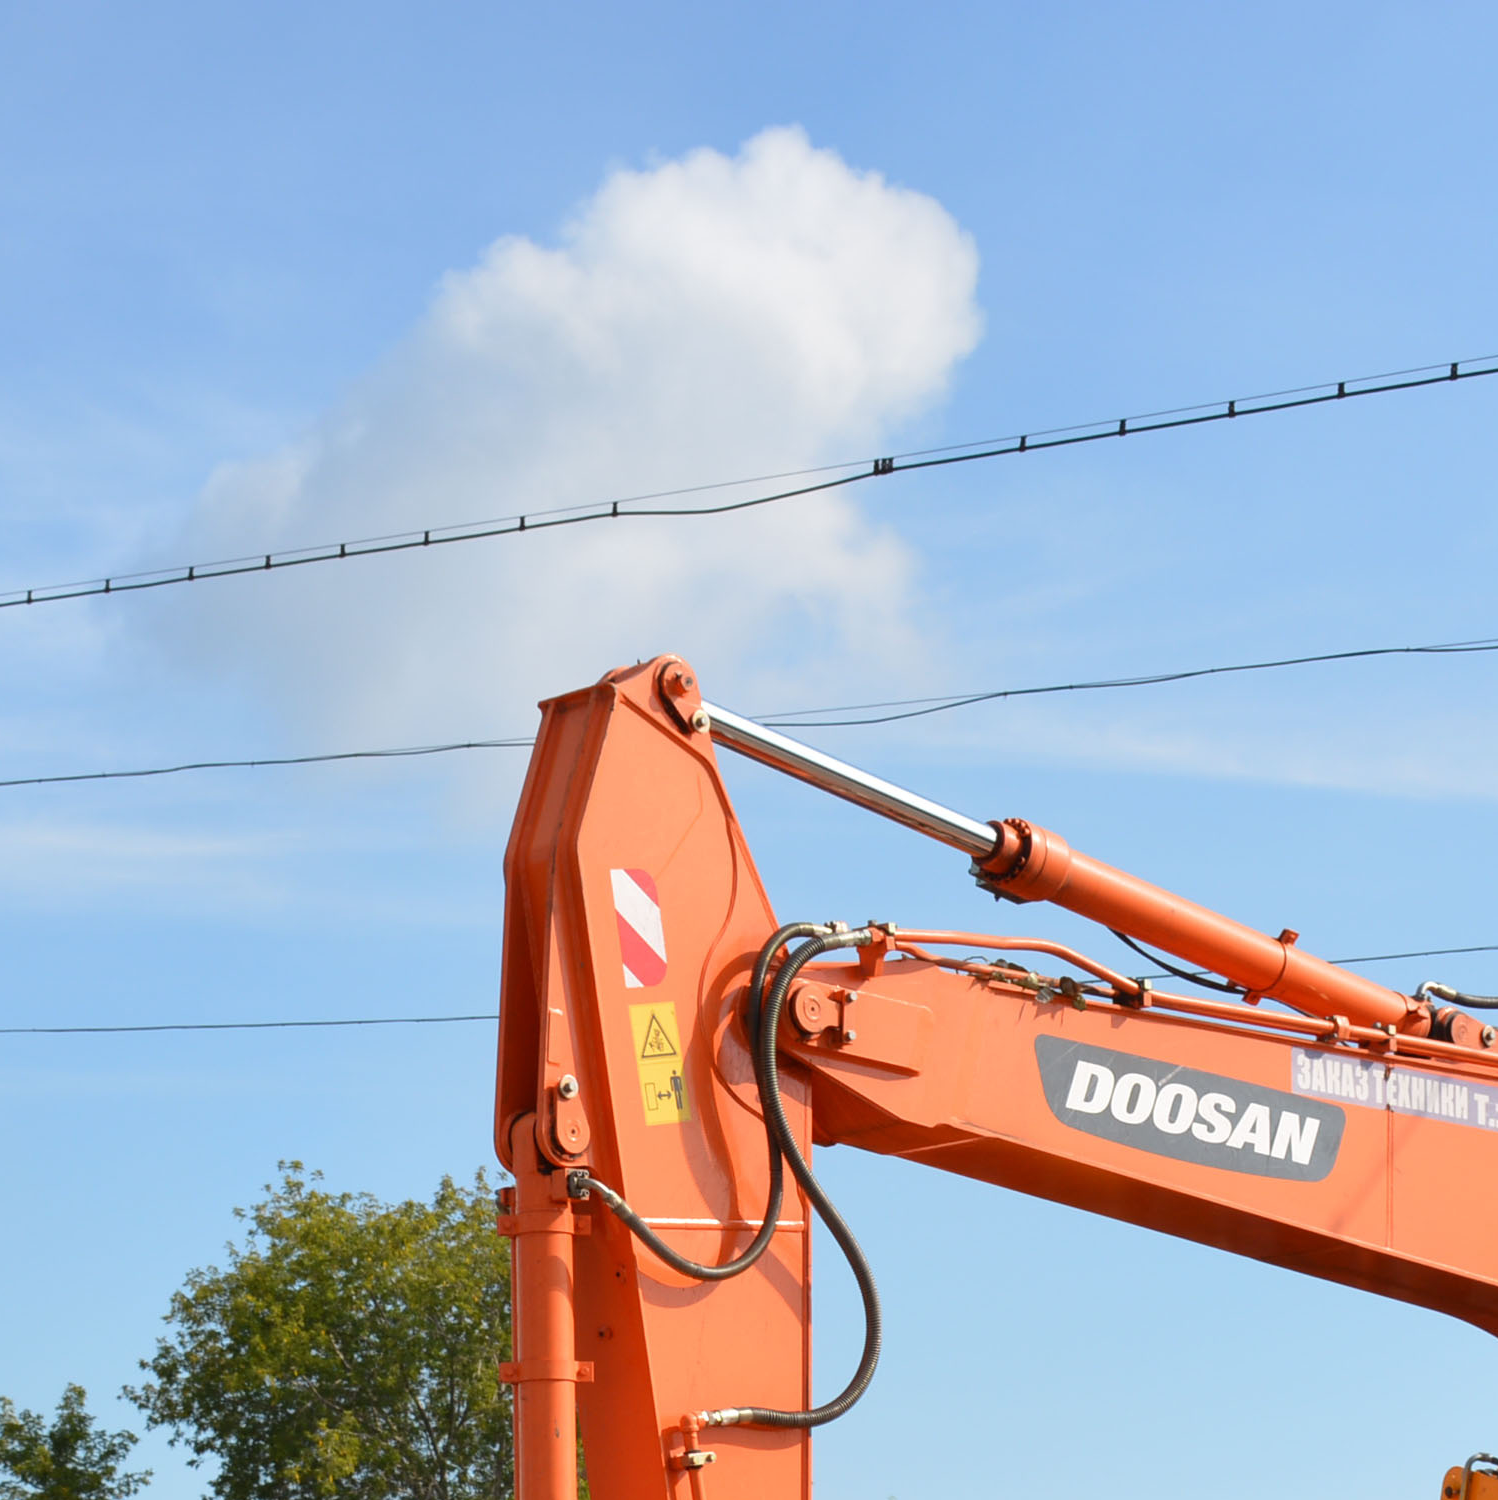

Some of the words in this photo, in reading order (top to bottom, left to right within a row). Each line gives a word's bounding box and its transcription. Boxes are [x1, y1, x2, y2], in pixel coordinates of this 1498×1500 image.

[1065, 1060, 1321, 1165] DOOSAN
[1297, 1052, 1370, 1101] ЗАКАЗ
[1372, 1068, 1469, 1121] ТЕХНИКИ
